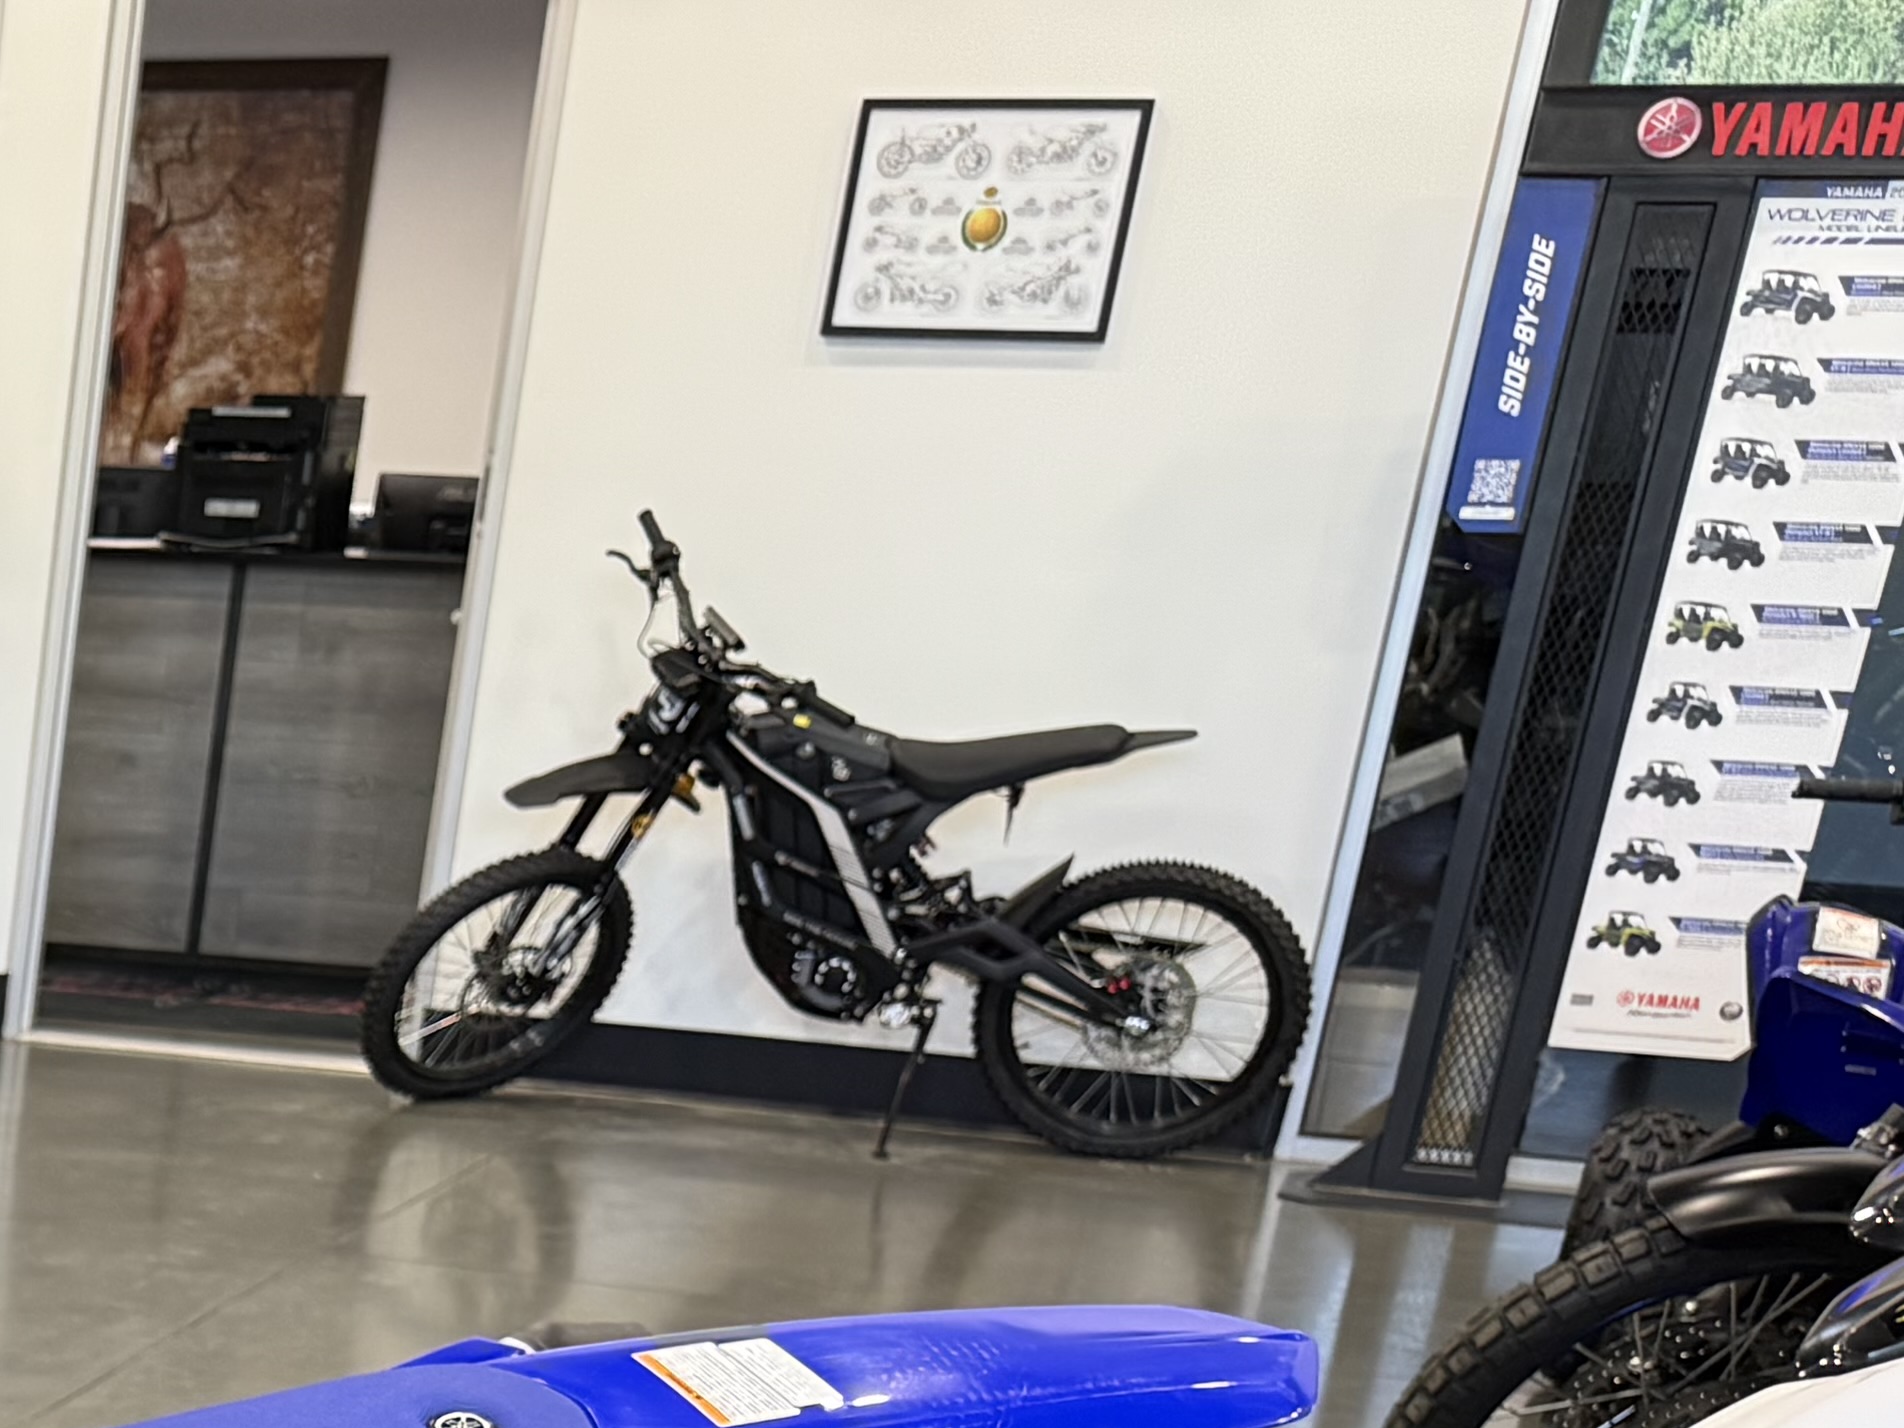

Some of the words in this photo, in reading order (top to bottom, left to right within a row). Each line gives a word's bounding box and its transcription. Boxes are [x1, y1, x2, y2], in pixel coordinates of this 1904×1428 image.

[1712, 102, 1904, 156] YAMAH
[1826, 186, 1883, 198] YAMAHA
[1768, 208, 1898, 222] WOLVERINE
[1498, 234, 1556, 417] SIDE-BY-SIDE
[1636, 993, 1701, 1011] YAMAHA
